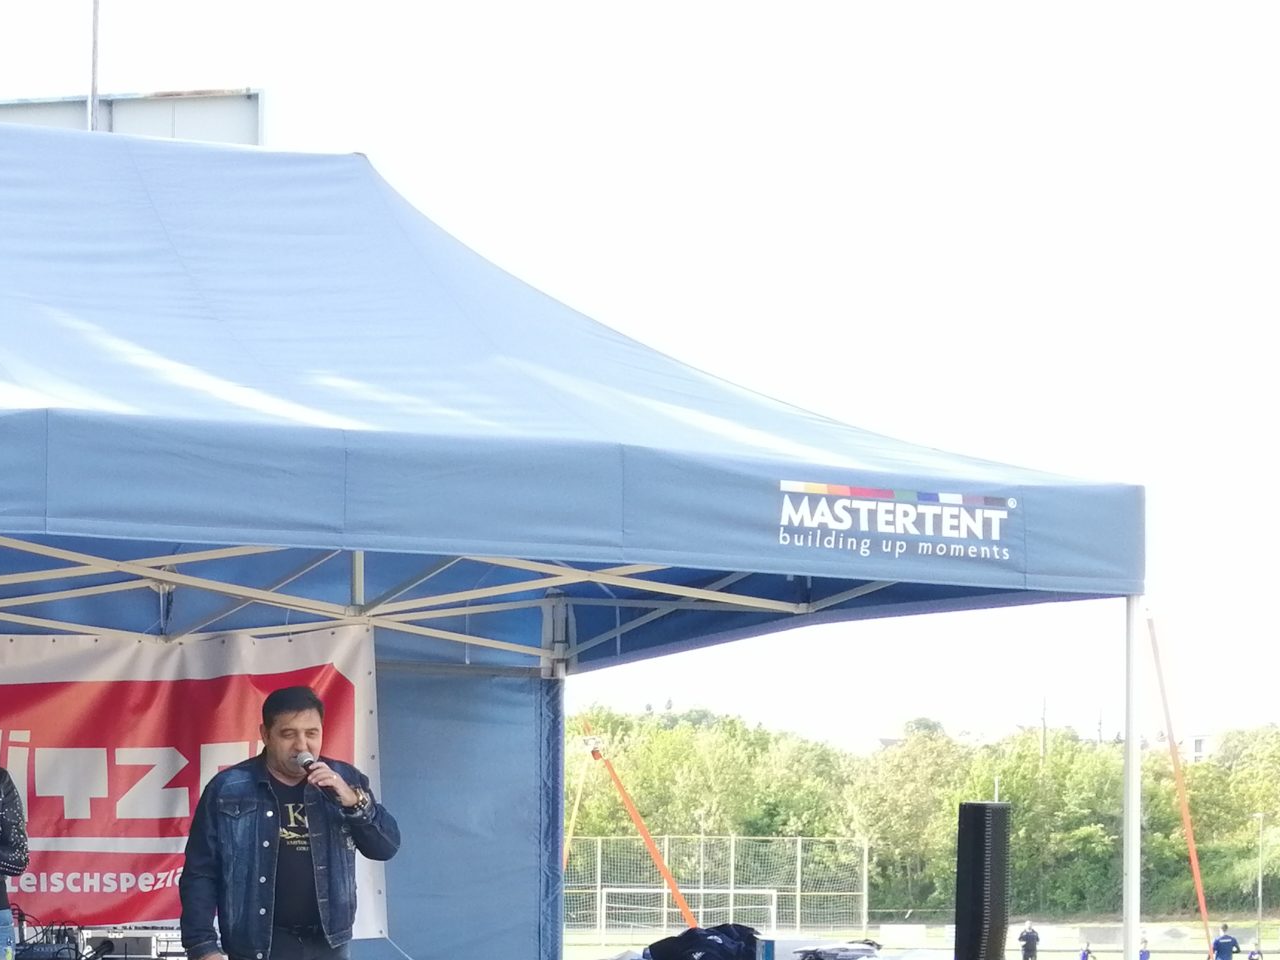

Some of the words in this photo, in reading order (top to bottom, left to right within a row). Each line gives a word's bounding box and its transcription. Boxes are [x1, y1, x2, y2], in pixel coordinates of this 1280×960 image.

[778, 527, 871, 556] building
[882, 539, 907, 558] up
[918, 541, 1011, 560] moments
